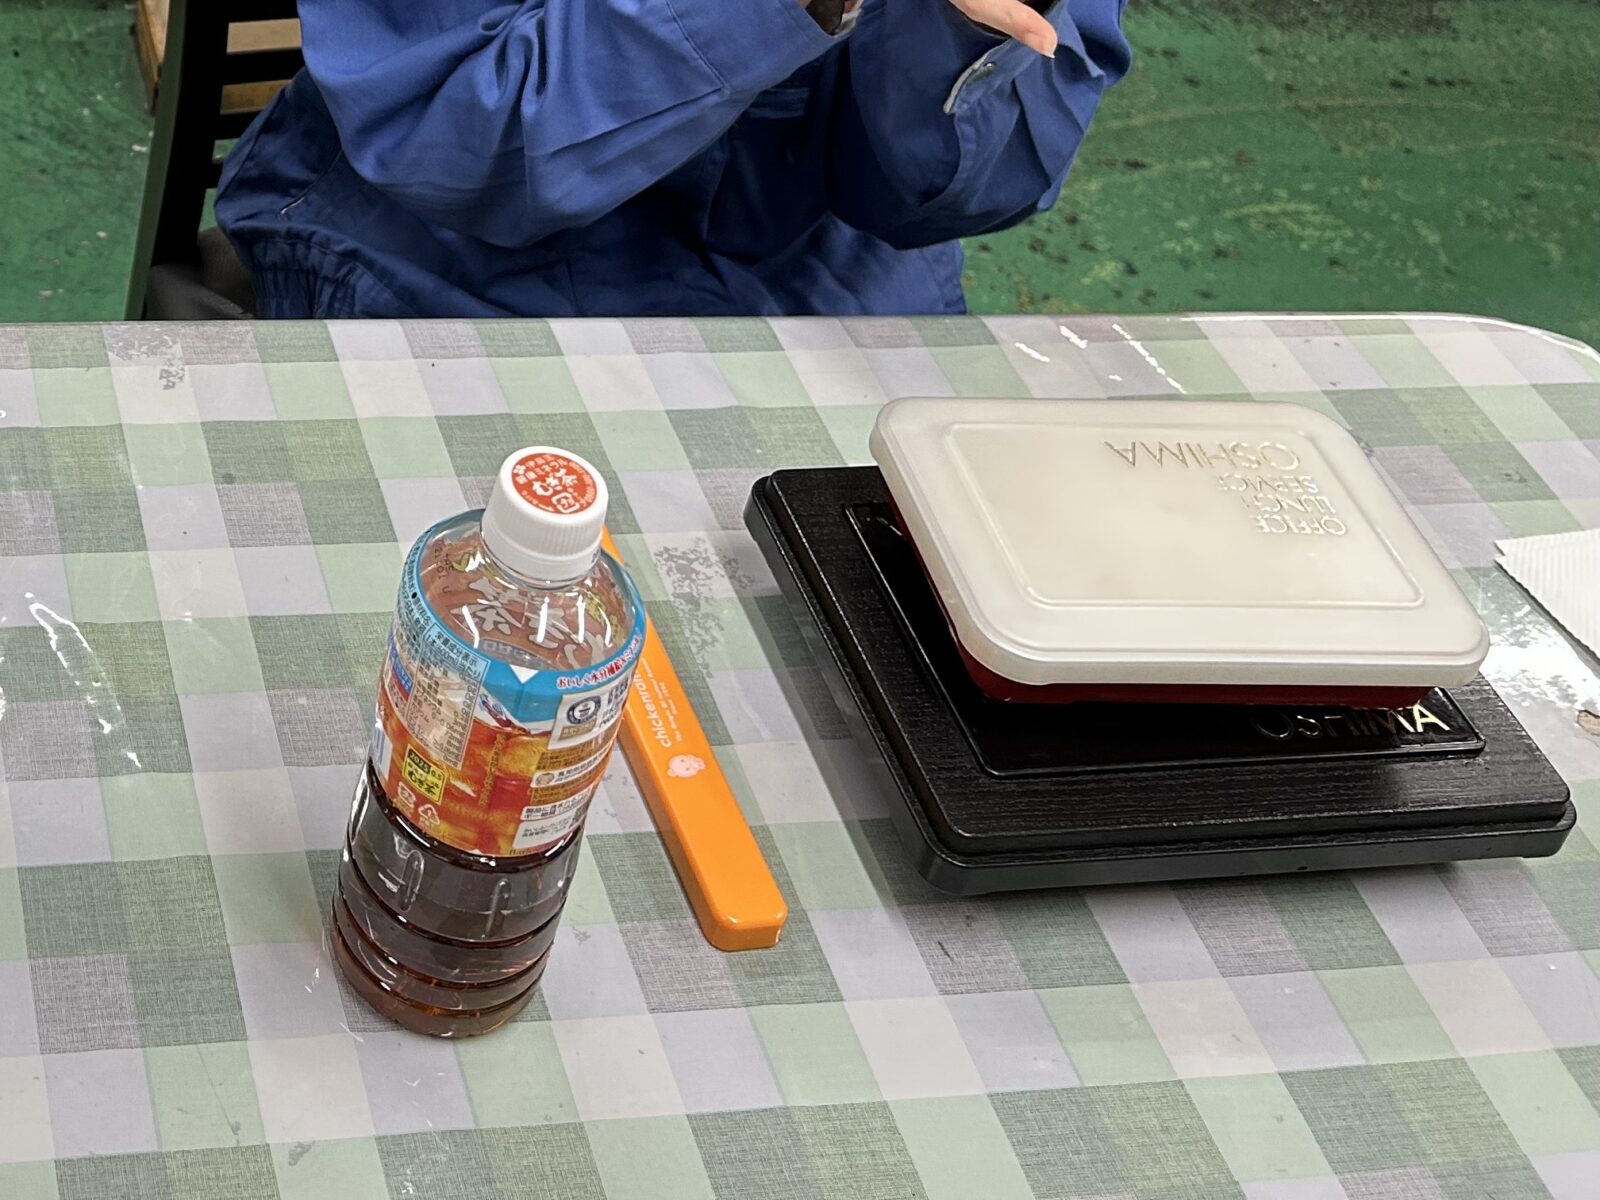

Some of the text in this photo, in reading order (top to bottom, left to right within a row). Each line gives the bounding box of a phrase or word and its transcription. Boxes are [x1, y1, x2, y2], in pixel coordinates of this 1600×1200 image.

[1104, 441, 1300, 471] OSHIMA
[1255, 514, 1347, 536] OFFICE
[633, 669, 672, 748] chickenram
